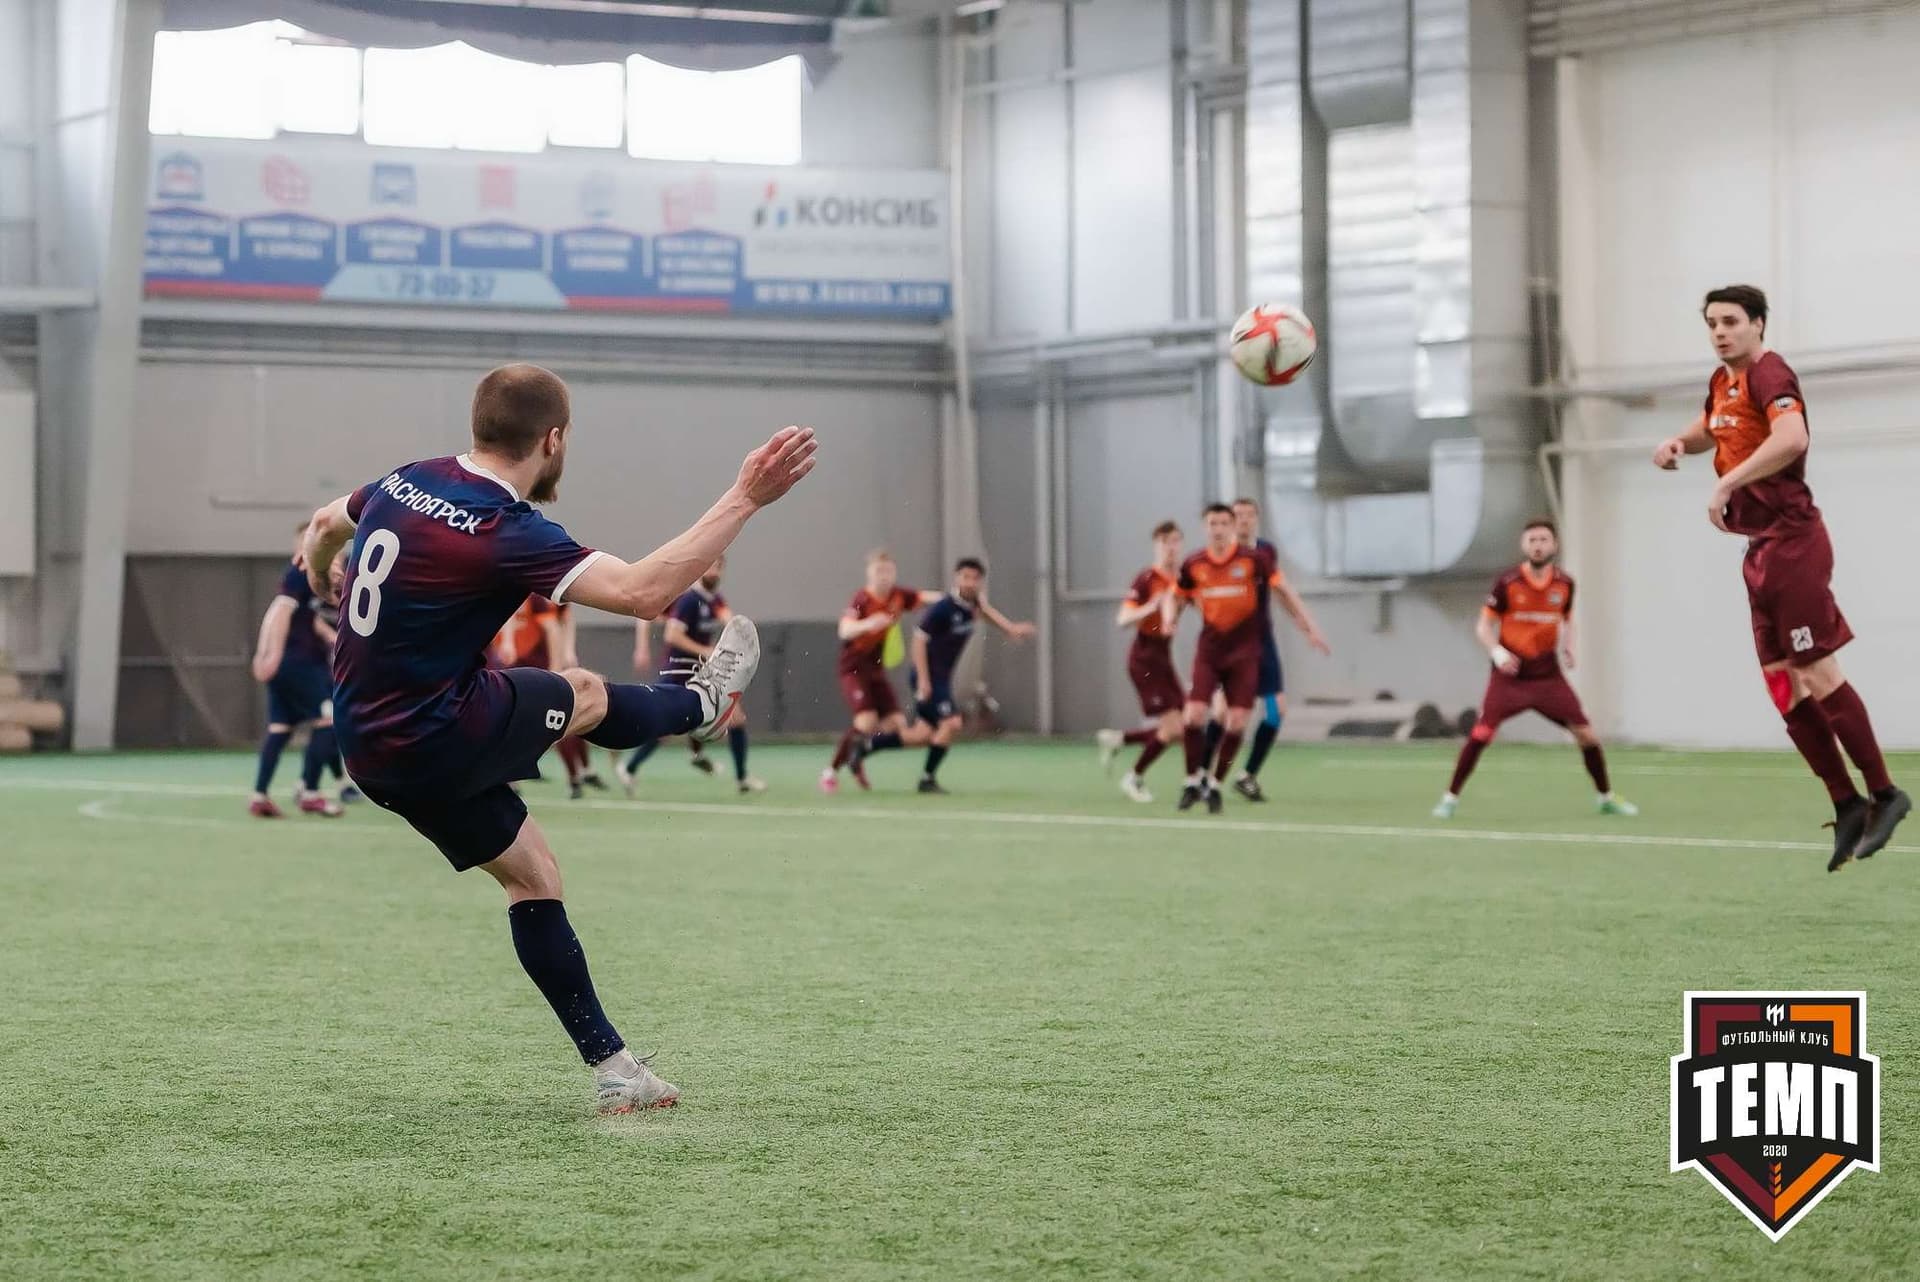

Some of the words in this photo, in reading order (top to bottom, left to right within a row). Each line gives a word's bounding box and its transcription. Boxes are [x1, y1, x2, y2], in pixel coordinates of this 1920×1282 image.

[796, 197, 939, 227] КОНСИБ
[381, 472, 483, 535] РАСНОЯРСК
[349, 528, 400, 637] 8
[1791, 626, 1814, 652] 23
[546, 709, 566, 730] 8
